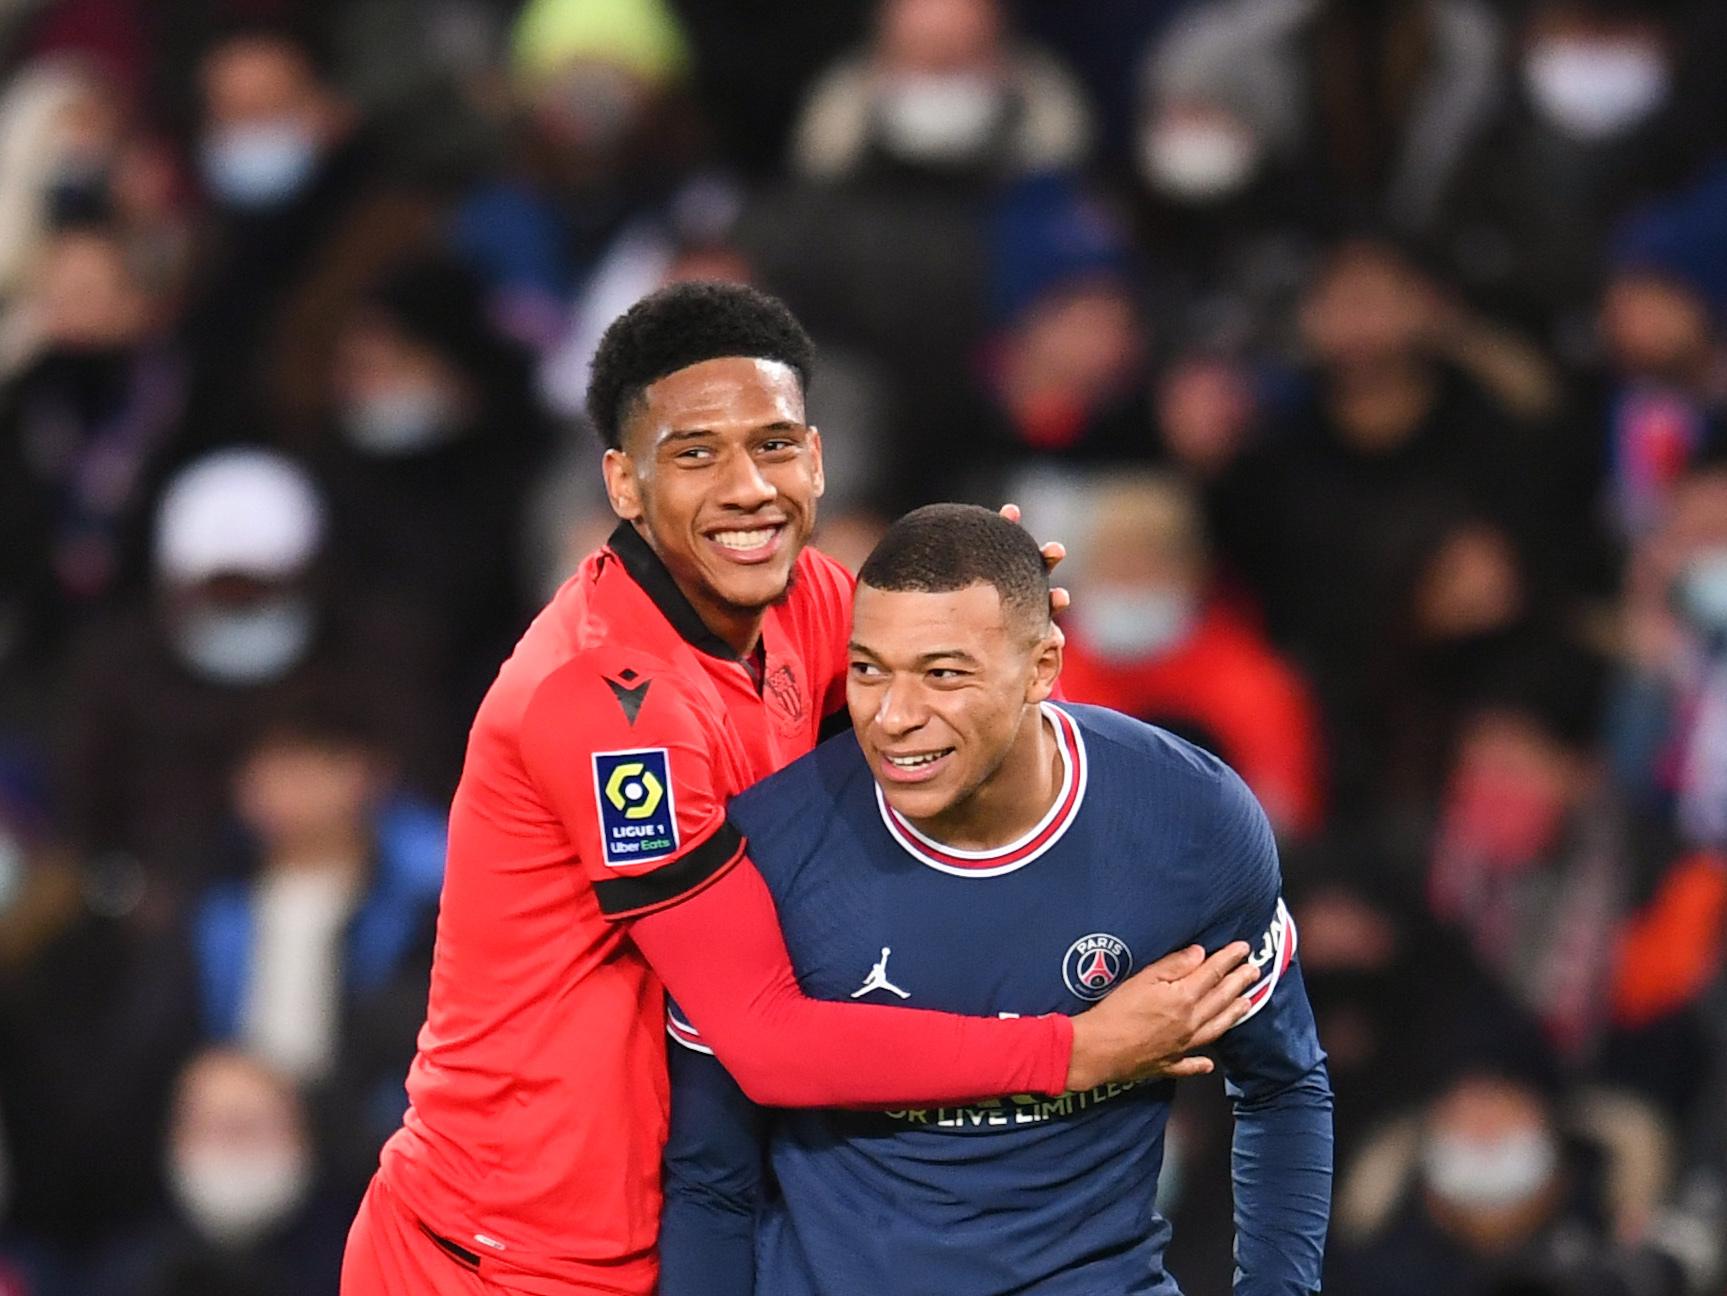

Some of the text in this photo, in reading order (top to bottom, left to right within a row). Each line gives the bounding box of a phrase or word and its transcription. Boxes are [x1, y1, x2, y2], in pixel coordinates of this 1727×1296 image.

[612, 824, 665, 838] LIGUE 1
[610, 839, 670, 853] Uber Eats
[1076, 937, 1124, 956] PARIS
[937, 1107, 1008, 1127] LIVE
[1015, 1079, 1143, 1124] LIMITLE
